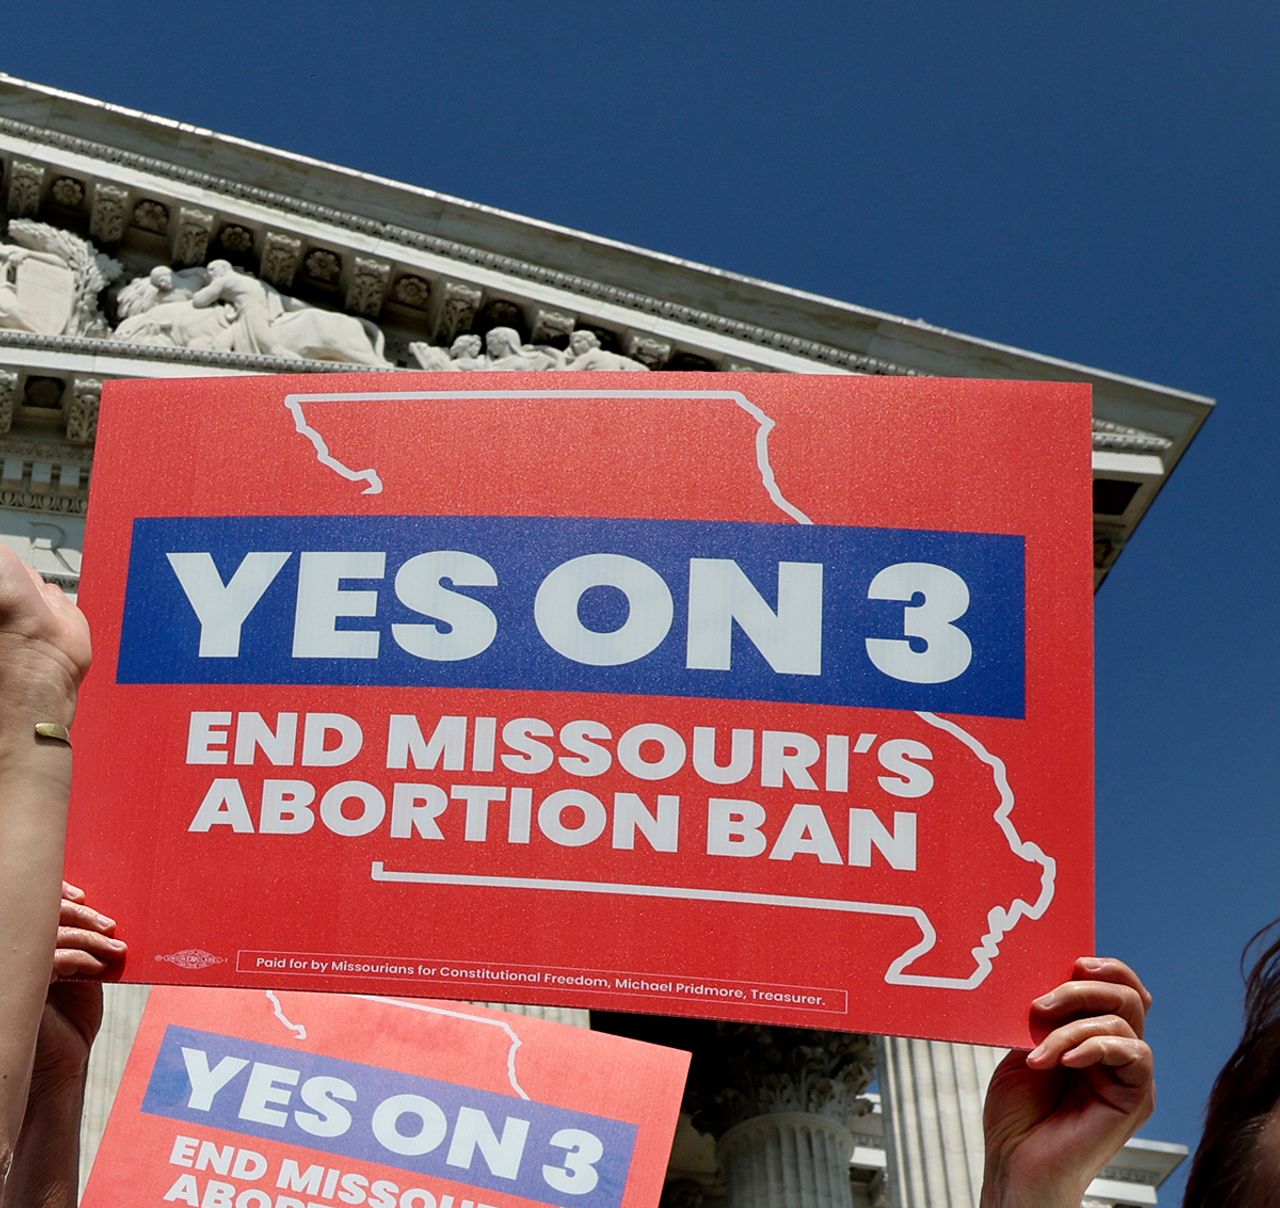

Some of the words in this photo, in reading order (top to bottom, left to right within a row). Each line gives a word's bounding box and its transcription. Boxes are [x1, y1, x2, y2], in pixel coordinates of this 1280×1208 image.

[165, 550, 499, 663] YES
[534, 553, 825, 677] ON
[864, 562, 973, 685] 3
[185, 710, 362, 770] END
[188, 778, 678, 854] ABORTION
[705, 799, 918, 872] BAN
[256, 956, 286, 969] Paid
[288, 958, 309, 970] for
[310, 959, 329, 973] by
[331, 960, 415, 977] Missourians
[417, 964, 438, 977] for
[440, 966, 541, 983] Constitutional
[544, 973, 611, 989] Freedom,
[615, 977, 673, 993] Michael
[676, 982, 747, 1000] Pridmore,
[751, 988, 826, 1007] Treasurer.
[168, 1135, 268, 1182] END
[181, 1046, 358, 1138] YES
[371, 1094, 530, 1180] ON
[542, 1128, 604, 1196] 3
